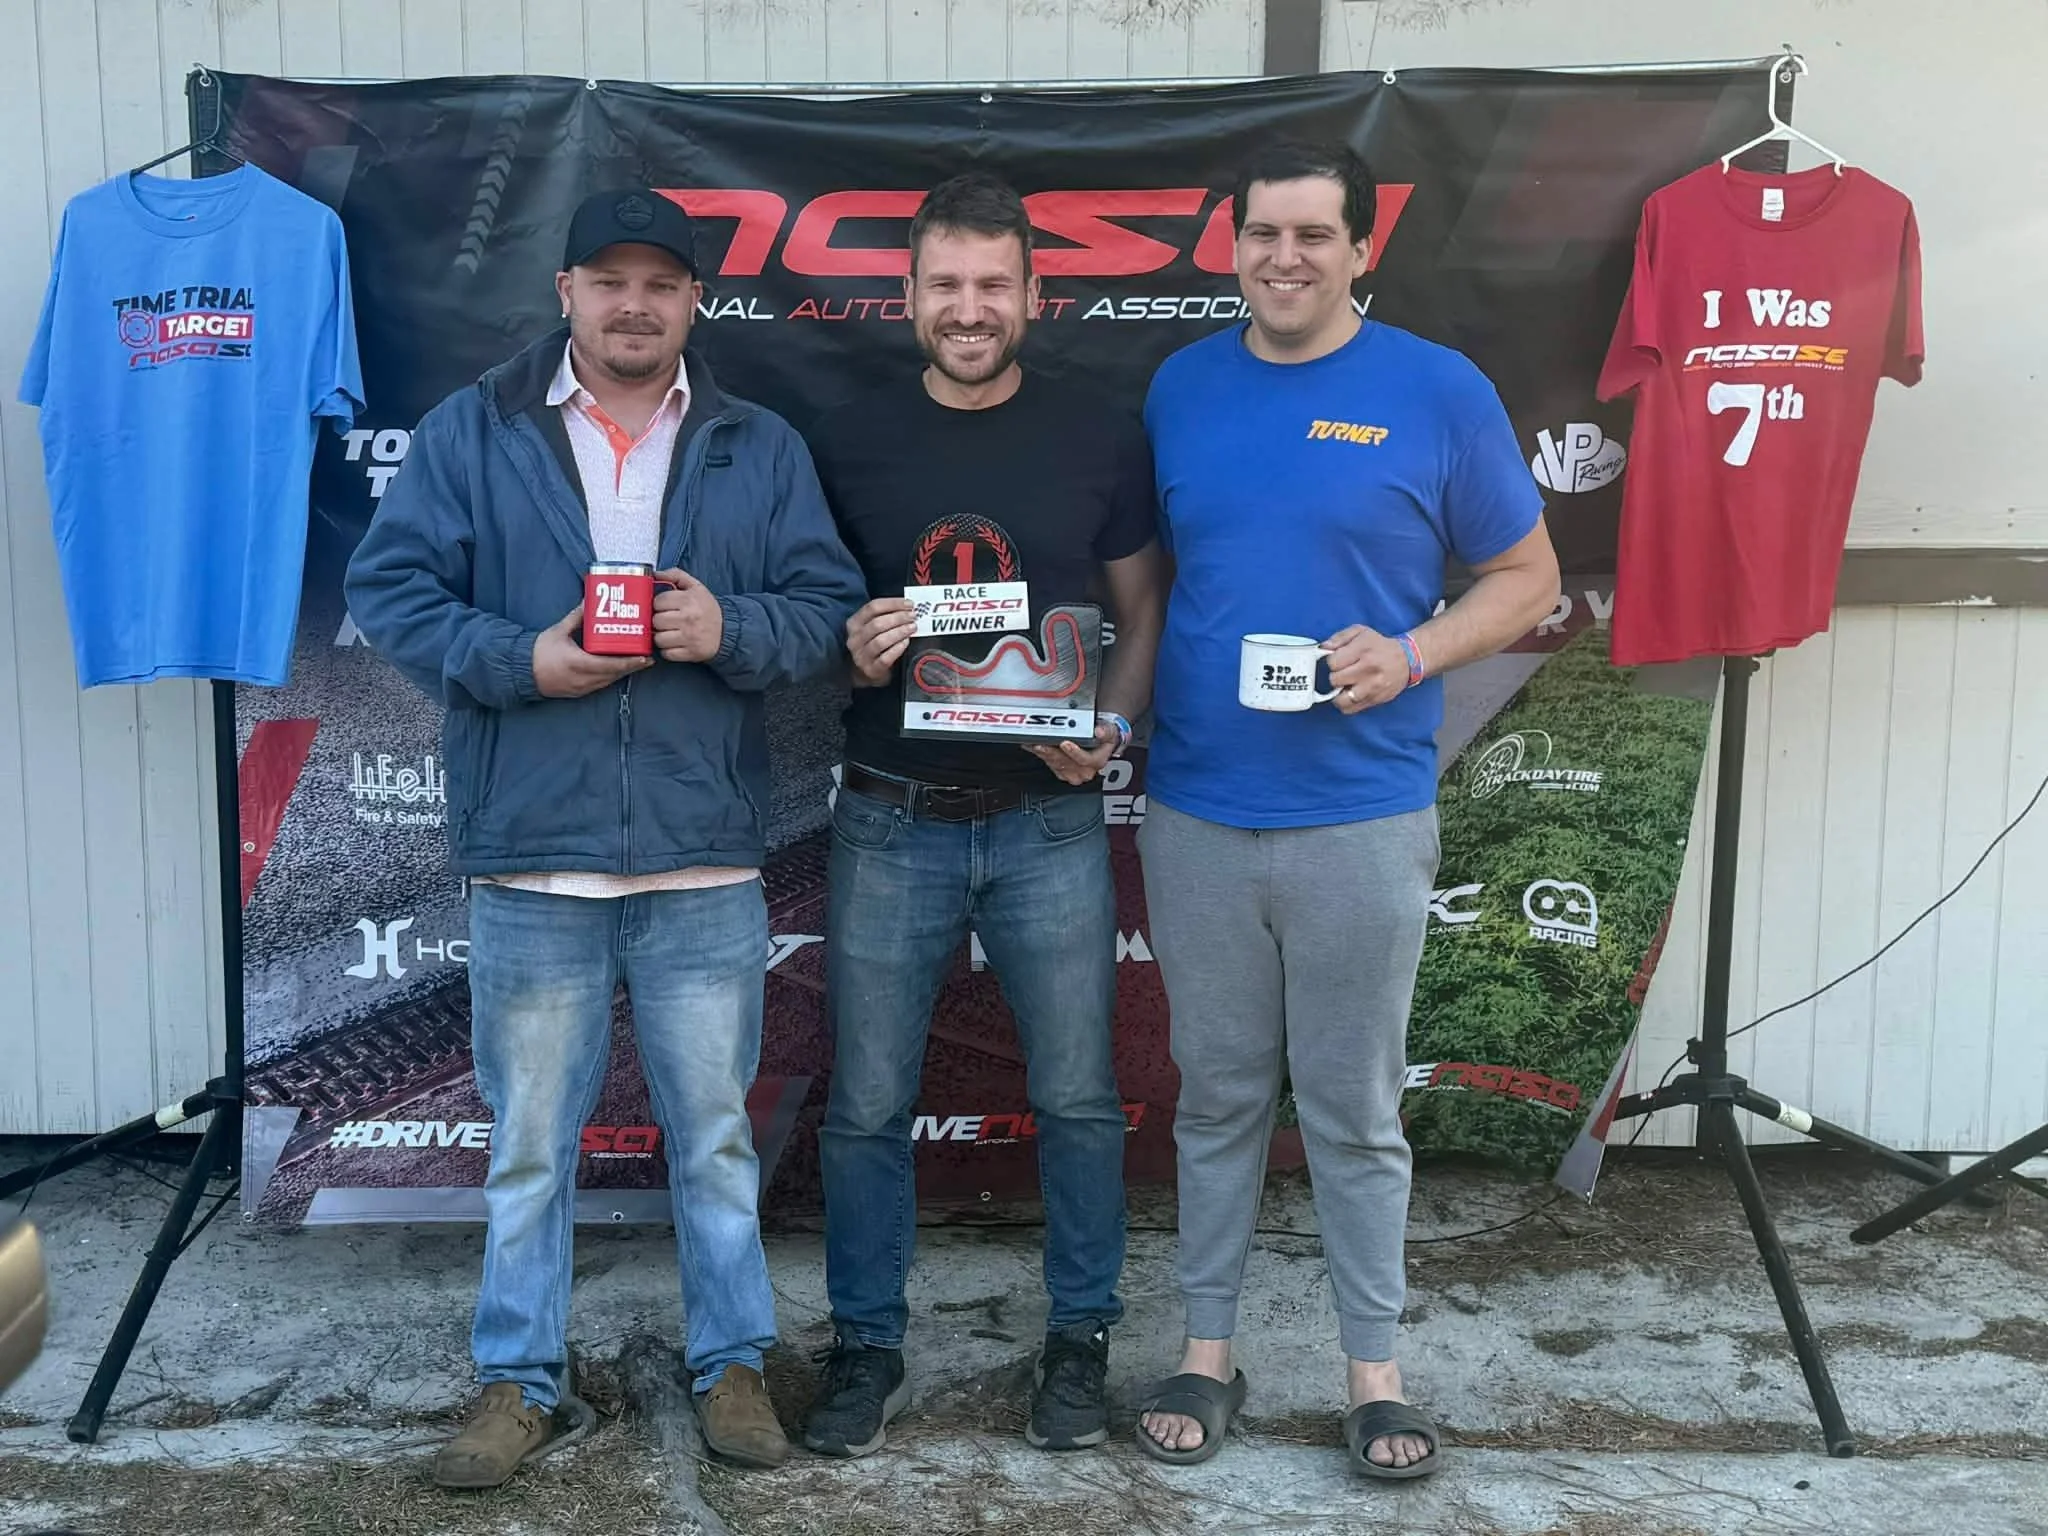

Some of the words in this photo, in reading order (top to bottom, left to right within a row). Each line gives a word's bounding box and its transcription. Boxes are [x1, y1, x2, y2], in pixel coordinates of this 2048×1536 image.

[113, 289, 177, 320] TIME
[183, 286, 255, 310] TRIAL
[1082, 296, 1373, 320] ASSOCIN
[1703, 290, 1723, 329] I
[1746, 288, 1832, 328] Was
[166, 315, 248, 339] TARGET
[1306, 420, 1389, 446] TURNER
[1707, 381, 1804, 467] 7th
[1536, 423, 1603, 493] VP
[1578, 456, 1626, 486] Racing
[953, 541, 975, 584] 1
[943, 586, 988, 600] RACE
[931, 615, 1006, 633] WINNER
[356, 809, 381, 824] Fire
[383, 811, 393, 824] &
[397, 811, 443, 828] Safety
[1528, 926, 1598, 948] RACING
